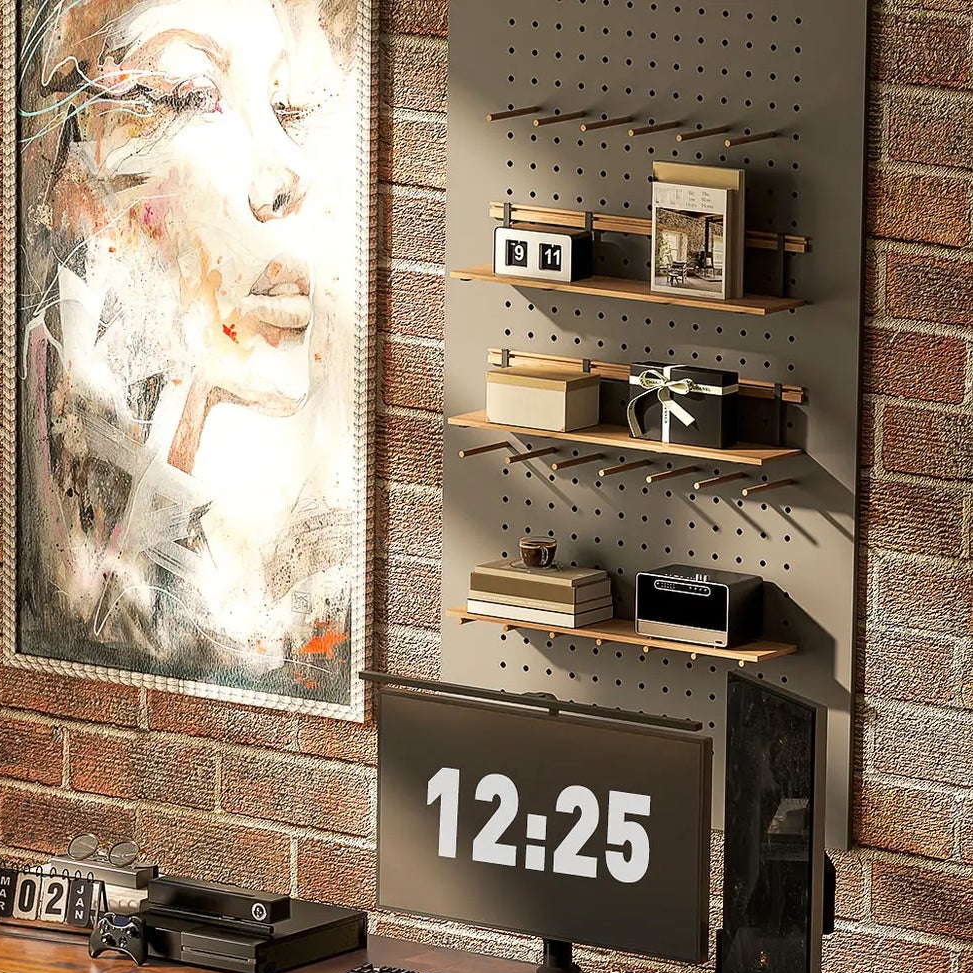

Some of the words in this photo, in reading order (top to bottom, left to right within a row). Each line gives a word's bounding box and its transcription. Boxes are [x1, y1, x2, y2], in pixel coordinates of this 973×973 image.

[514, 244, 524, 261] 9
[544, 248, 560, 266] 11
[427, 767, 651, 883] 12:25
[74, 885, 85, 919] JAN
